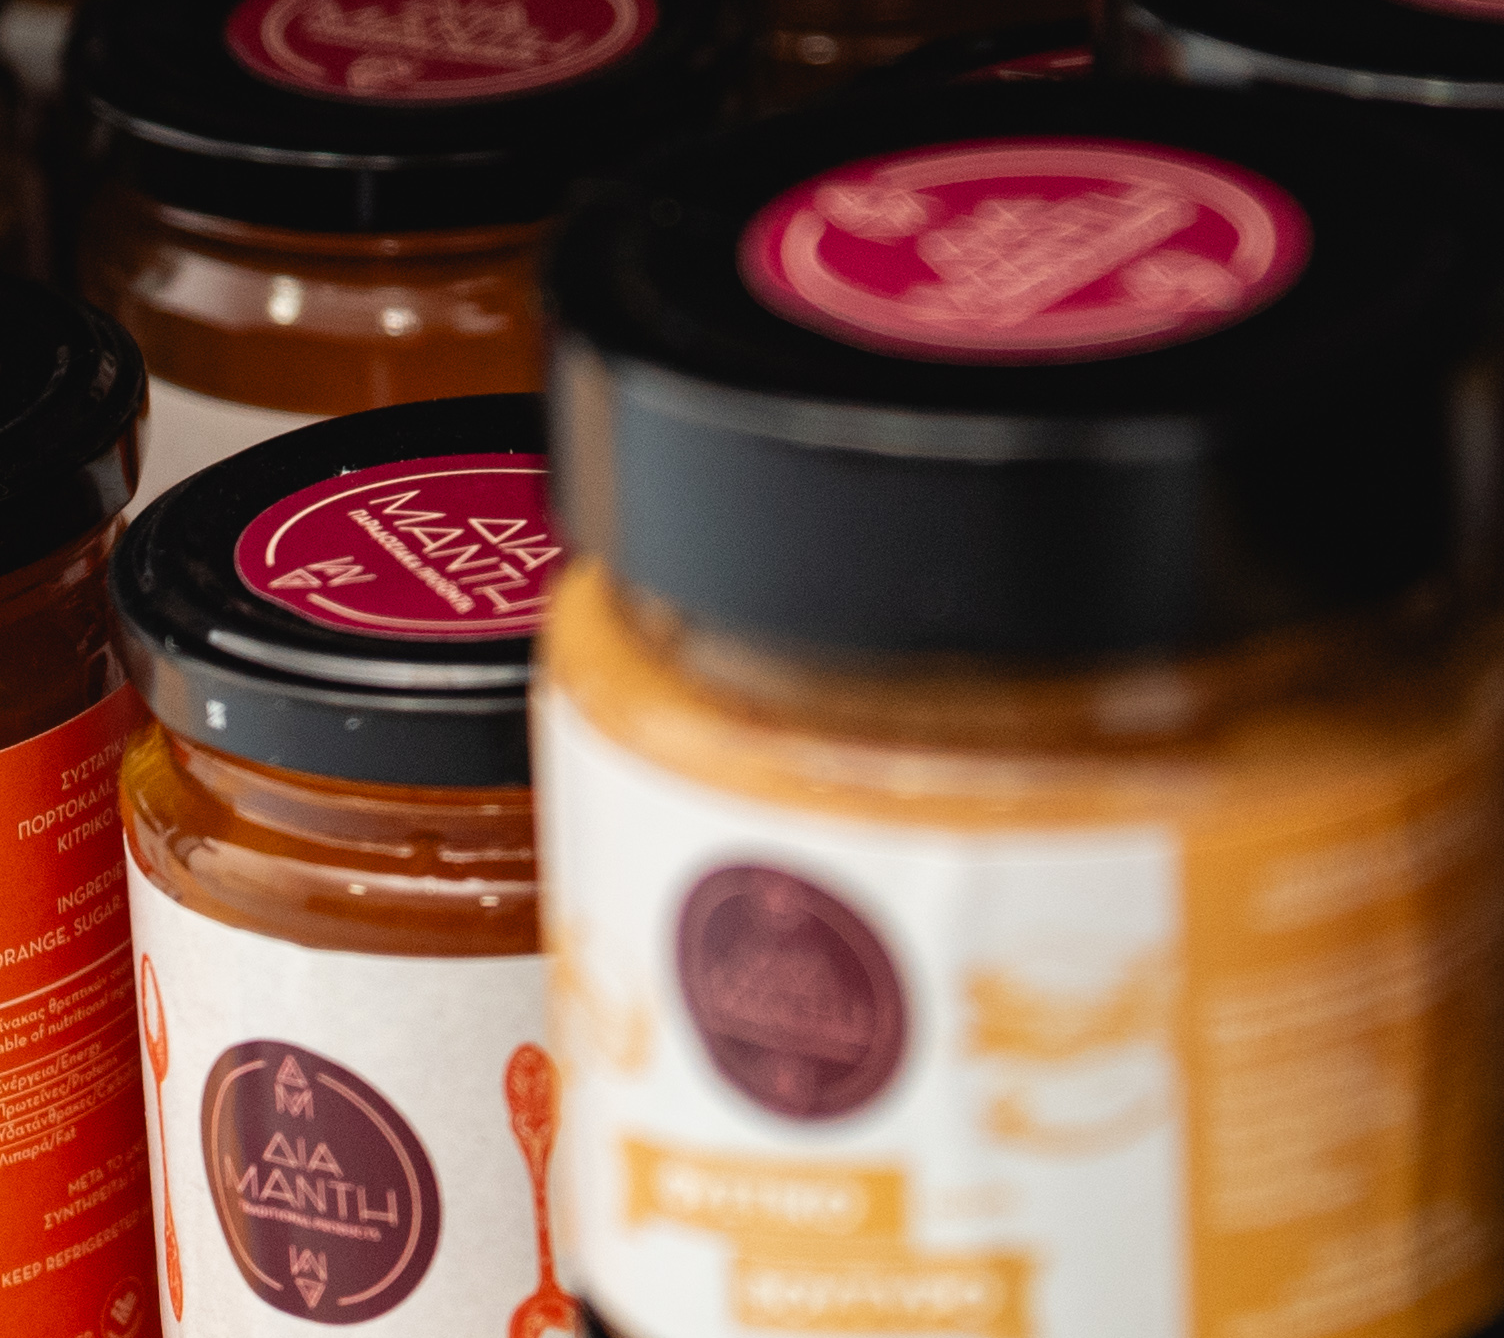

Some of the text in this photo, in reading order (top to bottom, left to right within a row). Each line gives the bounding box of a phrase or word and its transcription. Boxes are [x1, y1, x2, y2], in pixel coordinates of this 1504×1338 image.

[468, 517, 563, 572] ΔΙΑ
[30, 1024, 45, 1045] of
[261, 1129, 344, 1177] ΔΙΑ
[1, 1261, 42, 1289] KEEP
